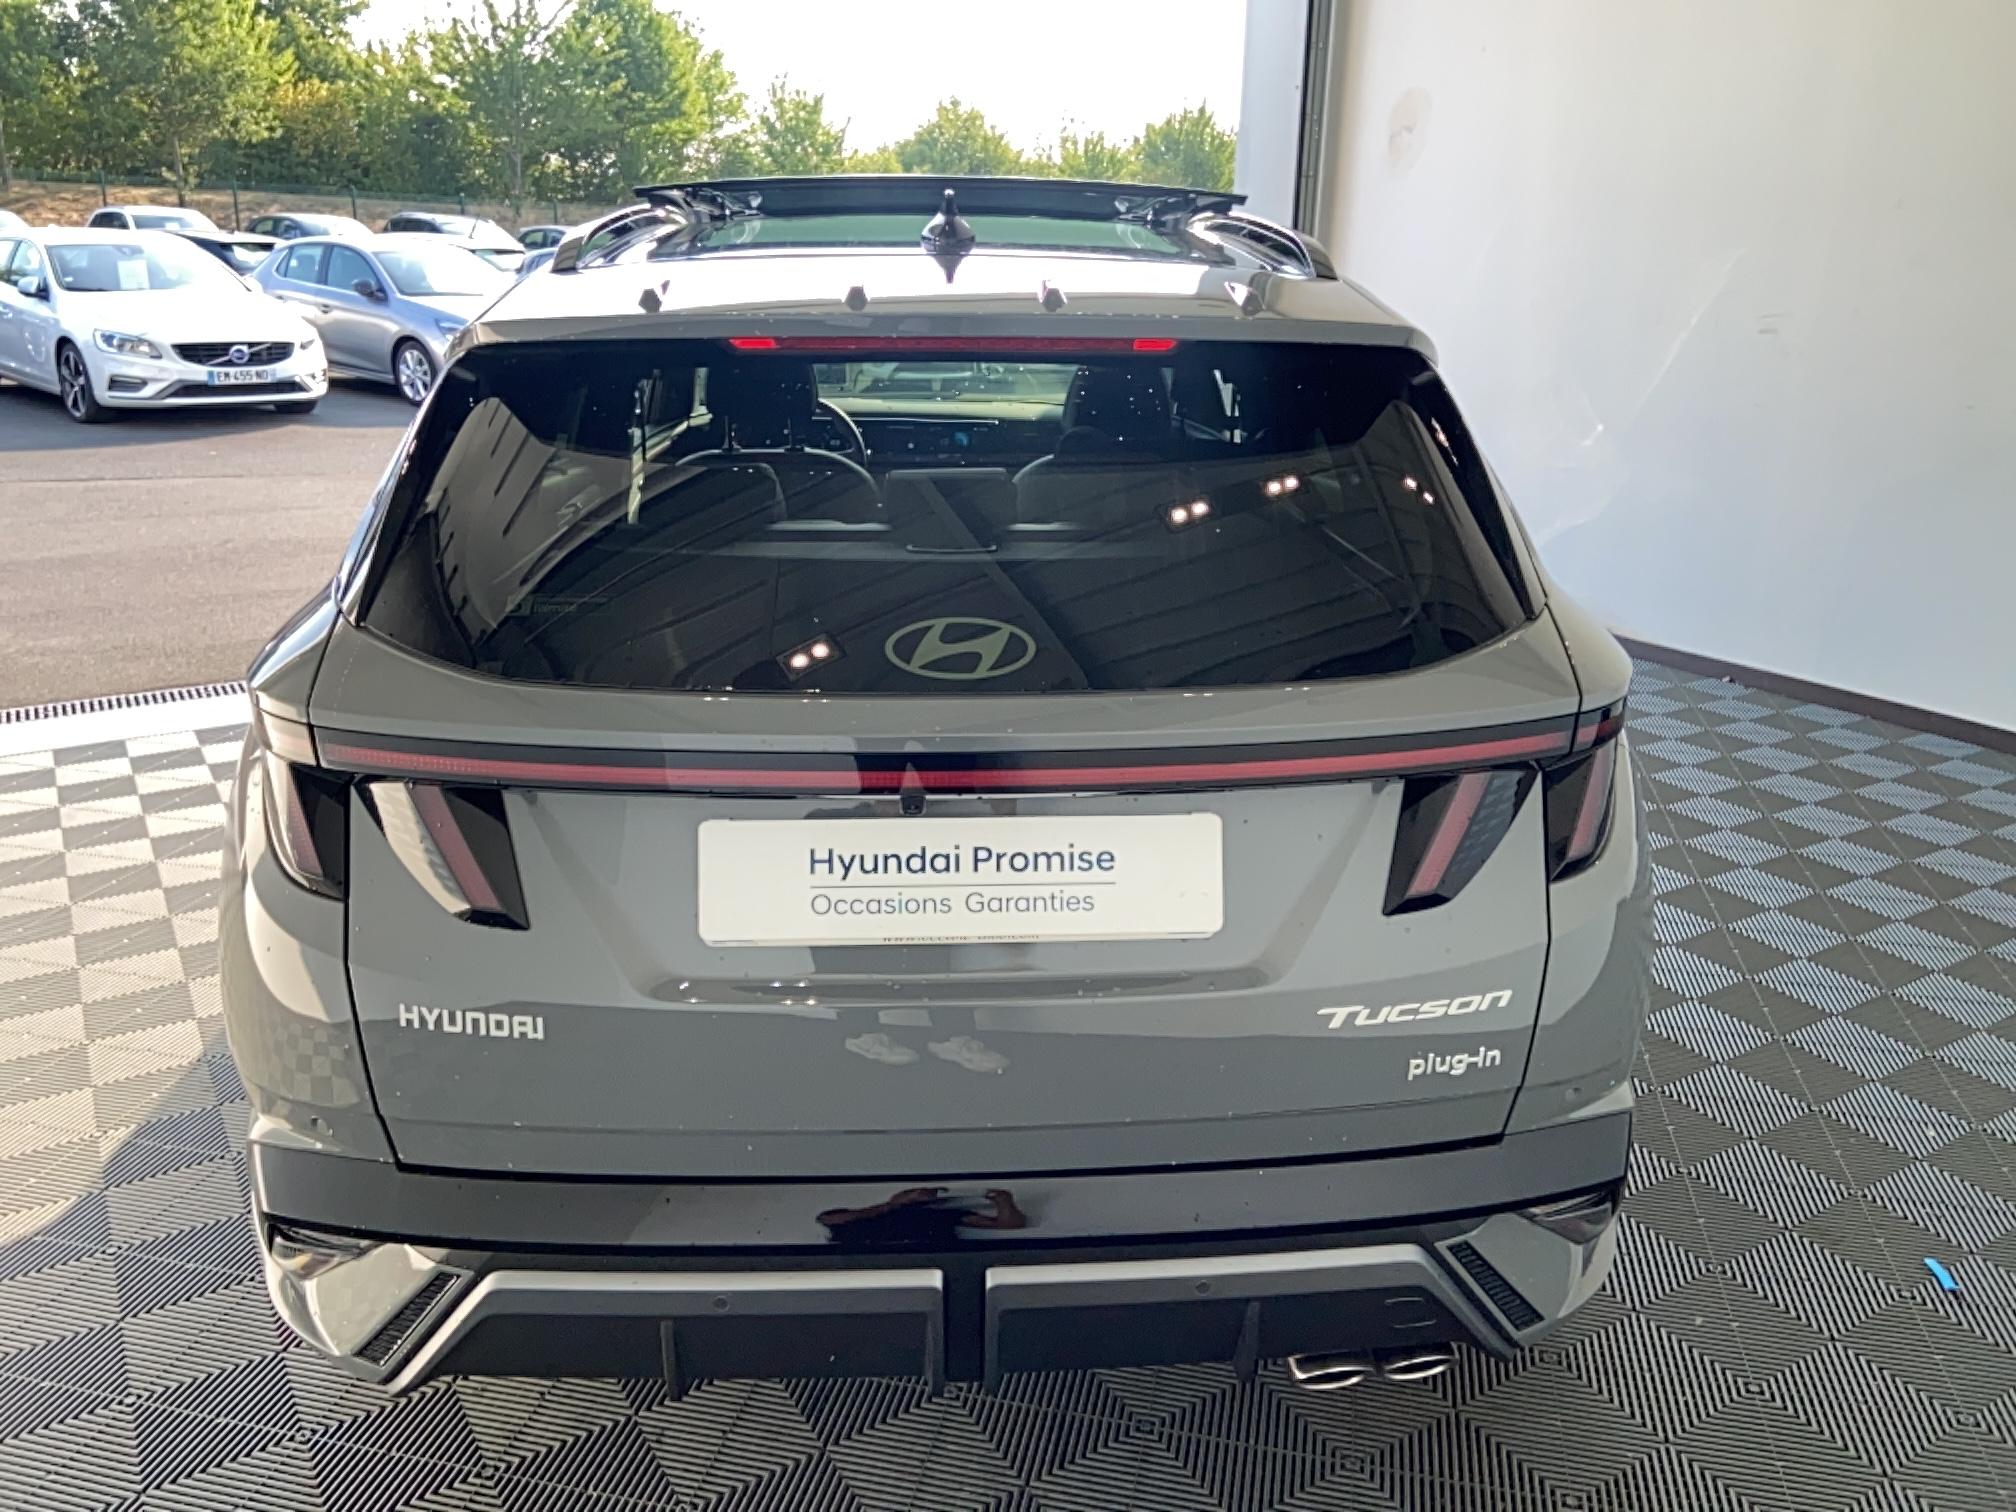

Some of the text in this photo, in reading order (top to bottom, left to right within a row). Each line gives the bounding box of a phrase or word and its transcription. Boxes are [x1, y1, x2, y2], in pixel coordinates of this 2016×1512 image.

[810, 843, 1115, 881] Hyundai Promise
[811, 890, 1095, 915] Occasions Garanties
[399, 1003, 545, 1040] HYUNDAI
[1407, 1046, 1501, 1081] plug-in
